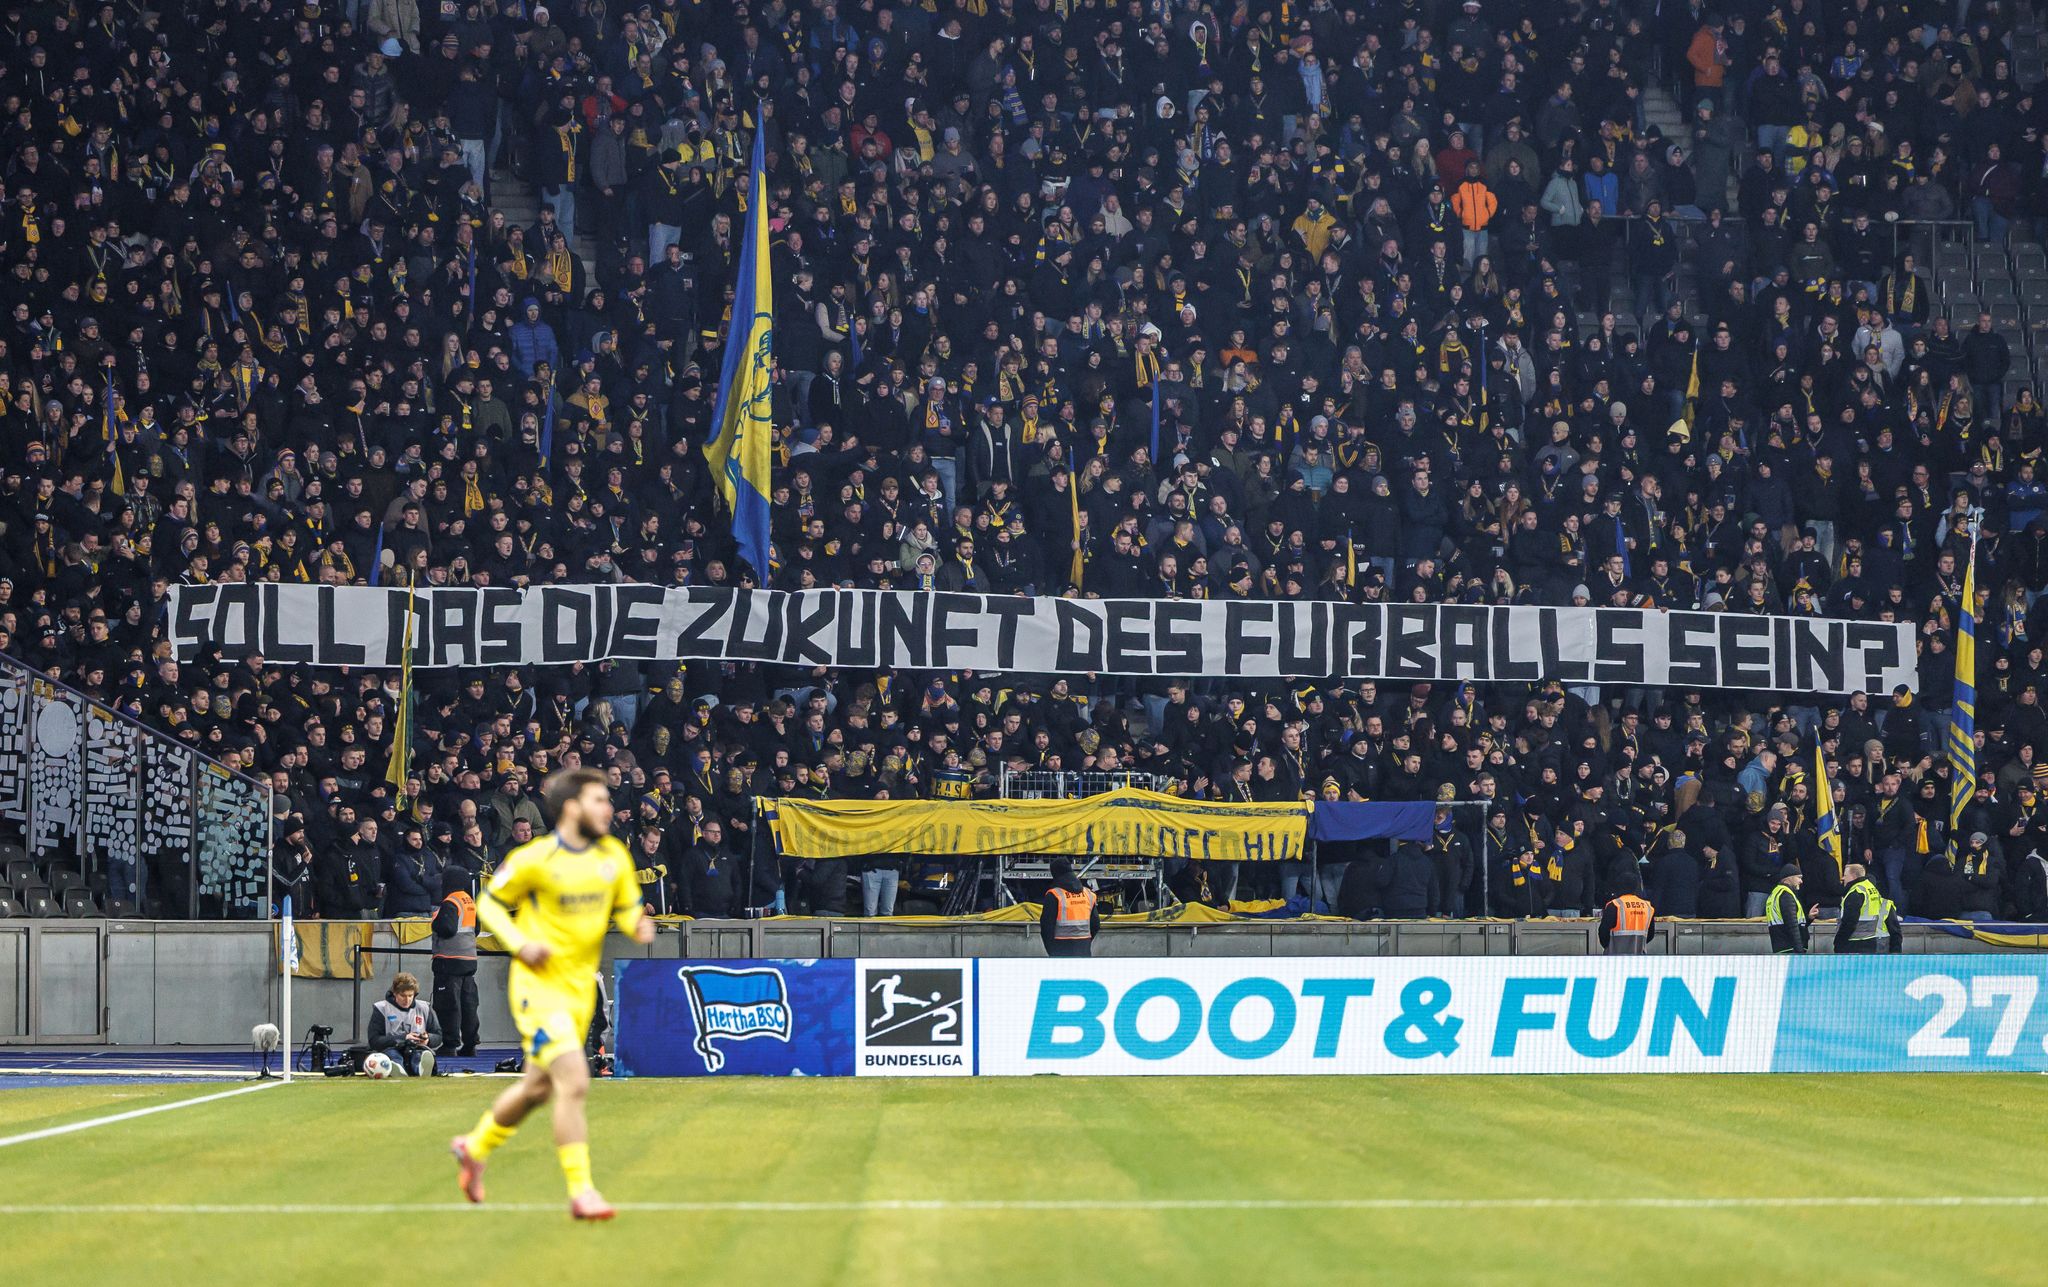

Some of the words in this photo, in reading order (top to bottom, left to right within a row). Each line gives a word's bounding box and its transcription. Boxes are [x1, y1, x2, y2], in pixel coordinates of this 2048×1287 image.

[174, 583, 366, 665] SOLL
[386, 588, 522, 666] DAS
[541, 585, 661, 661] DIE
[676, 585, 1036, 669] ZUKUNFT
[1055, 597, 1202, 674] DES
[1668, 611, 1899, 693] SEIN?
[1625, 901, 1646, 909] BEST
[707, 1006, 757, 1031] Hertha
[756, 1006, 784, 1028] BSC
[931, 1008, 957, 1041] 2
[1025, 976, 1376, 1061] BOOT
[1383, 976, 1465, 1060] &
[1490, 976, 1738, 1058] FUN
[1904, 974, 2048, 1057] 27
[864, 1054, 963, 1067] BUNDESLIGA
